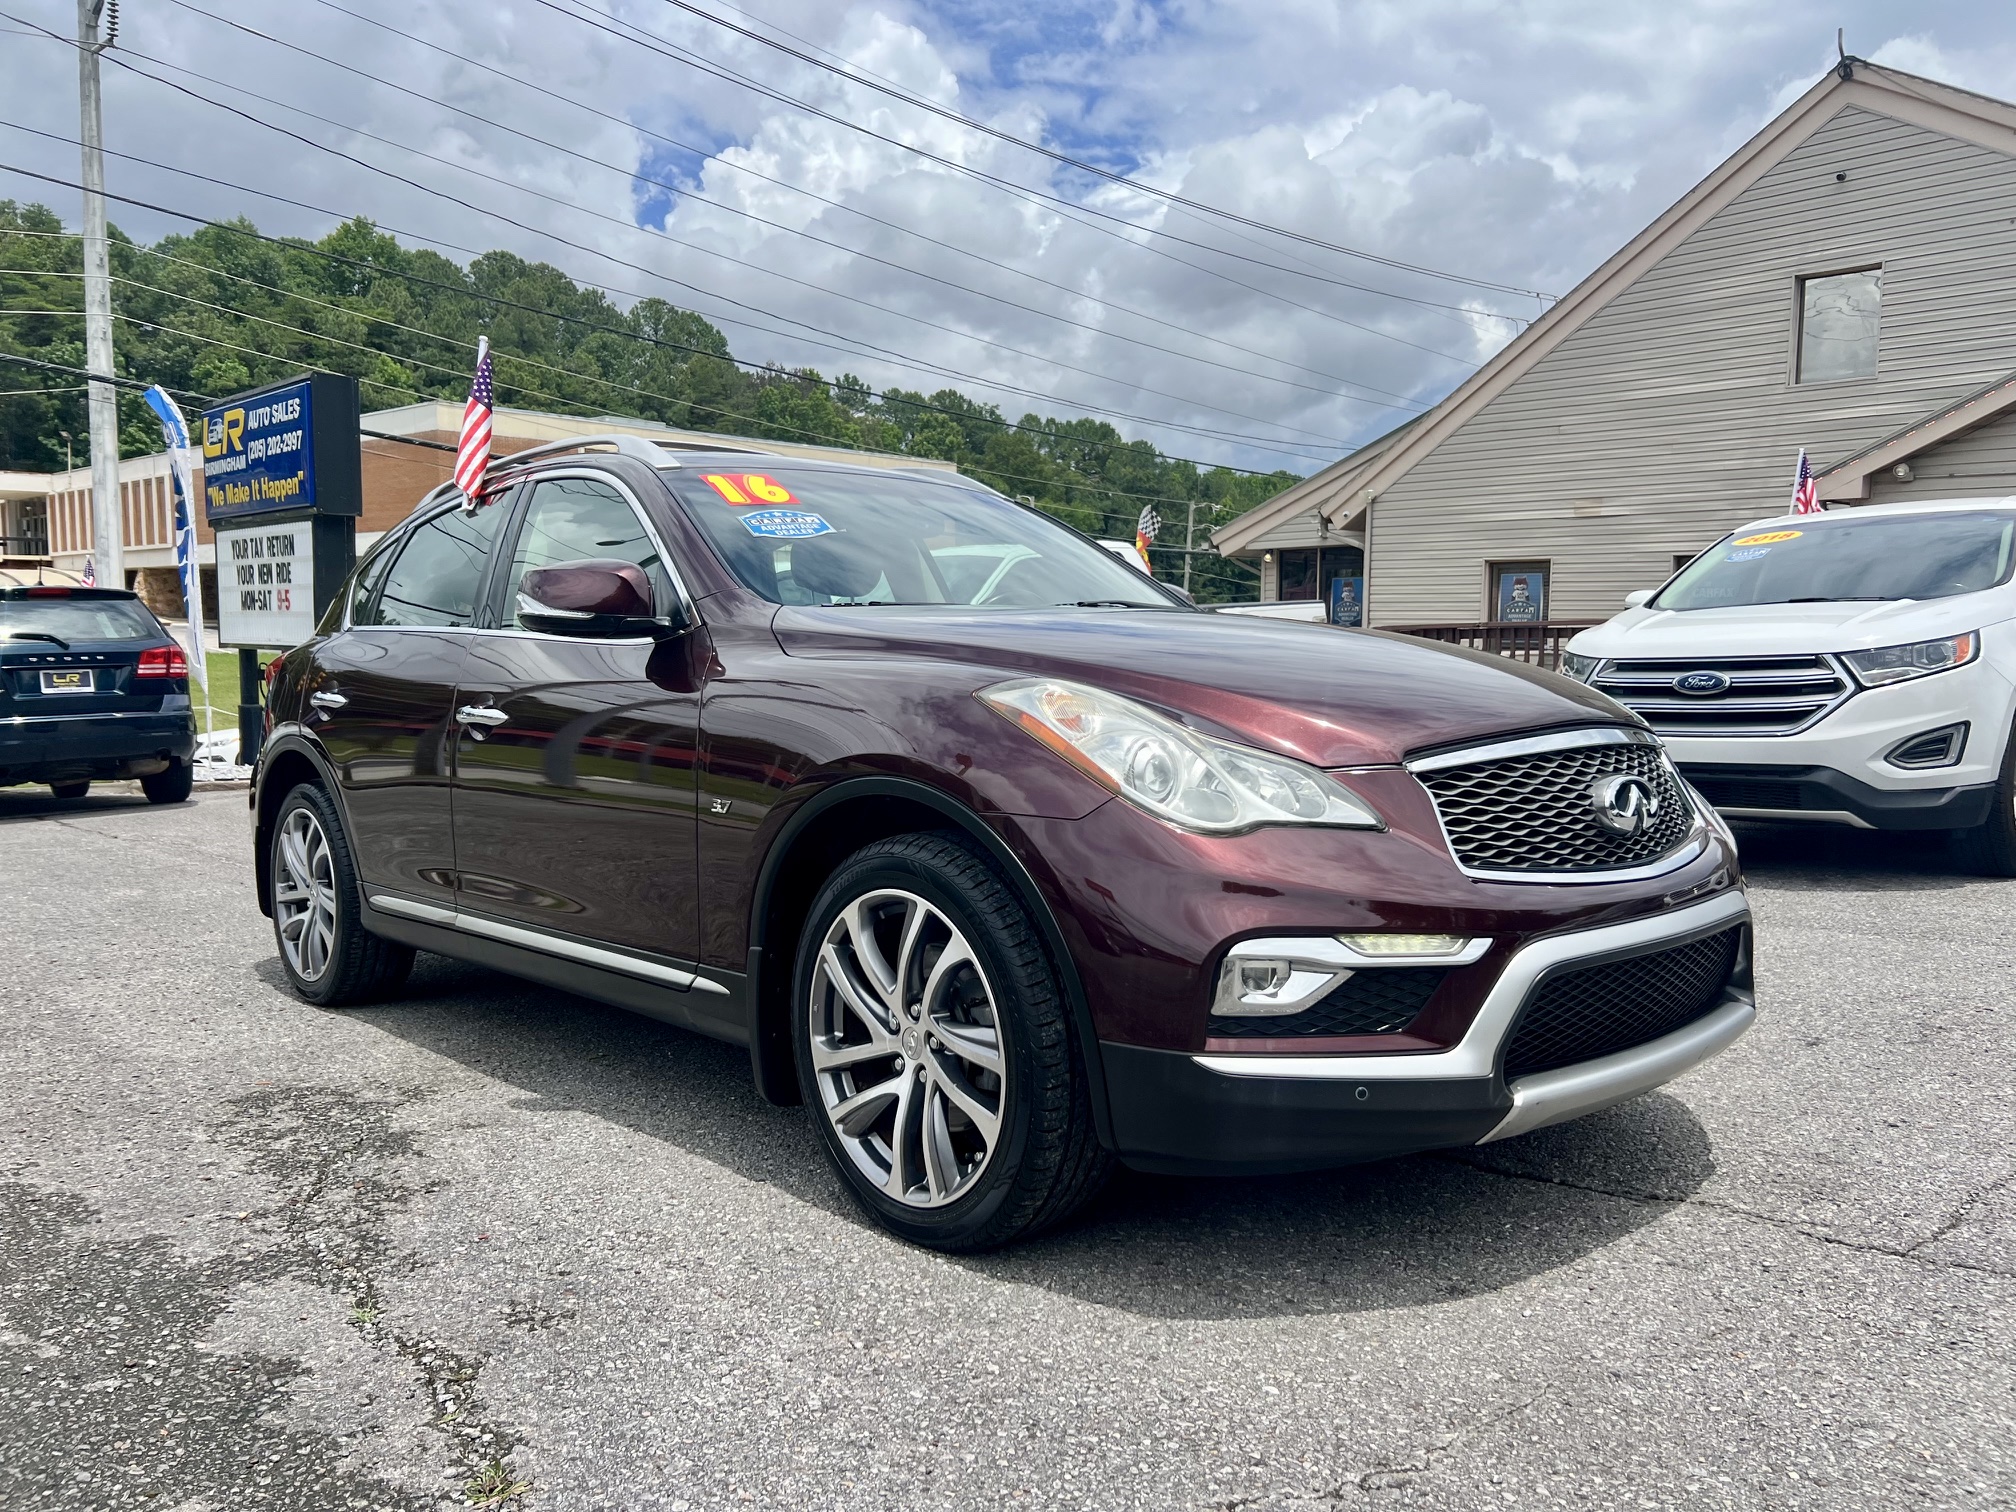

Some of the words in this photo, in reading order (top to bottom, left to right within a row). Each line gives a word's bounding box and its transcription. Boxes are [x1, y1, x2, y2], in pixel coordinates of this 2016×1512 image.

[248, 406, 271, 430] AUTO
[272, 398, 300, 424] SALES
[248, 438, 266, 465] (205)
[267, 430, 302, 456] 202-2997
[204, 454, 246, 477] BIRMINGHAM
[208, 485, 225, 508] "We
[225, 482, 250, 505] Make
[251, 479, 260, 501] It
[261, 471, 304, 502] Happen"
[707, 474, 791, 503] 16
[760, 523, 821, 531] ADVANTAGE
[1738, 532, 1796, 544] 2018
[231, 539, 249, 560] YOUR
[250, 537, 264, 558] TAX
[266, 534, 295, 557] RETURN
[236, 564, 255, 585] YOUR
[257, 563, 273, 584] NEW
[276, 562, 292, 583] RIDE
[240, 590, 272, 611] MON-SAT
[277, 589, 291, 611] 9-5
[52, 673, 80, 683] LR
[1685, 676, 1716, 688] Ford
